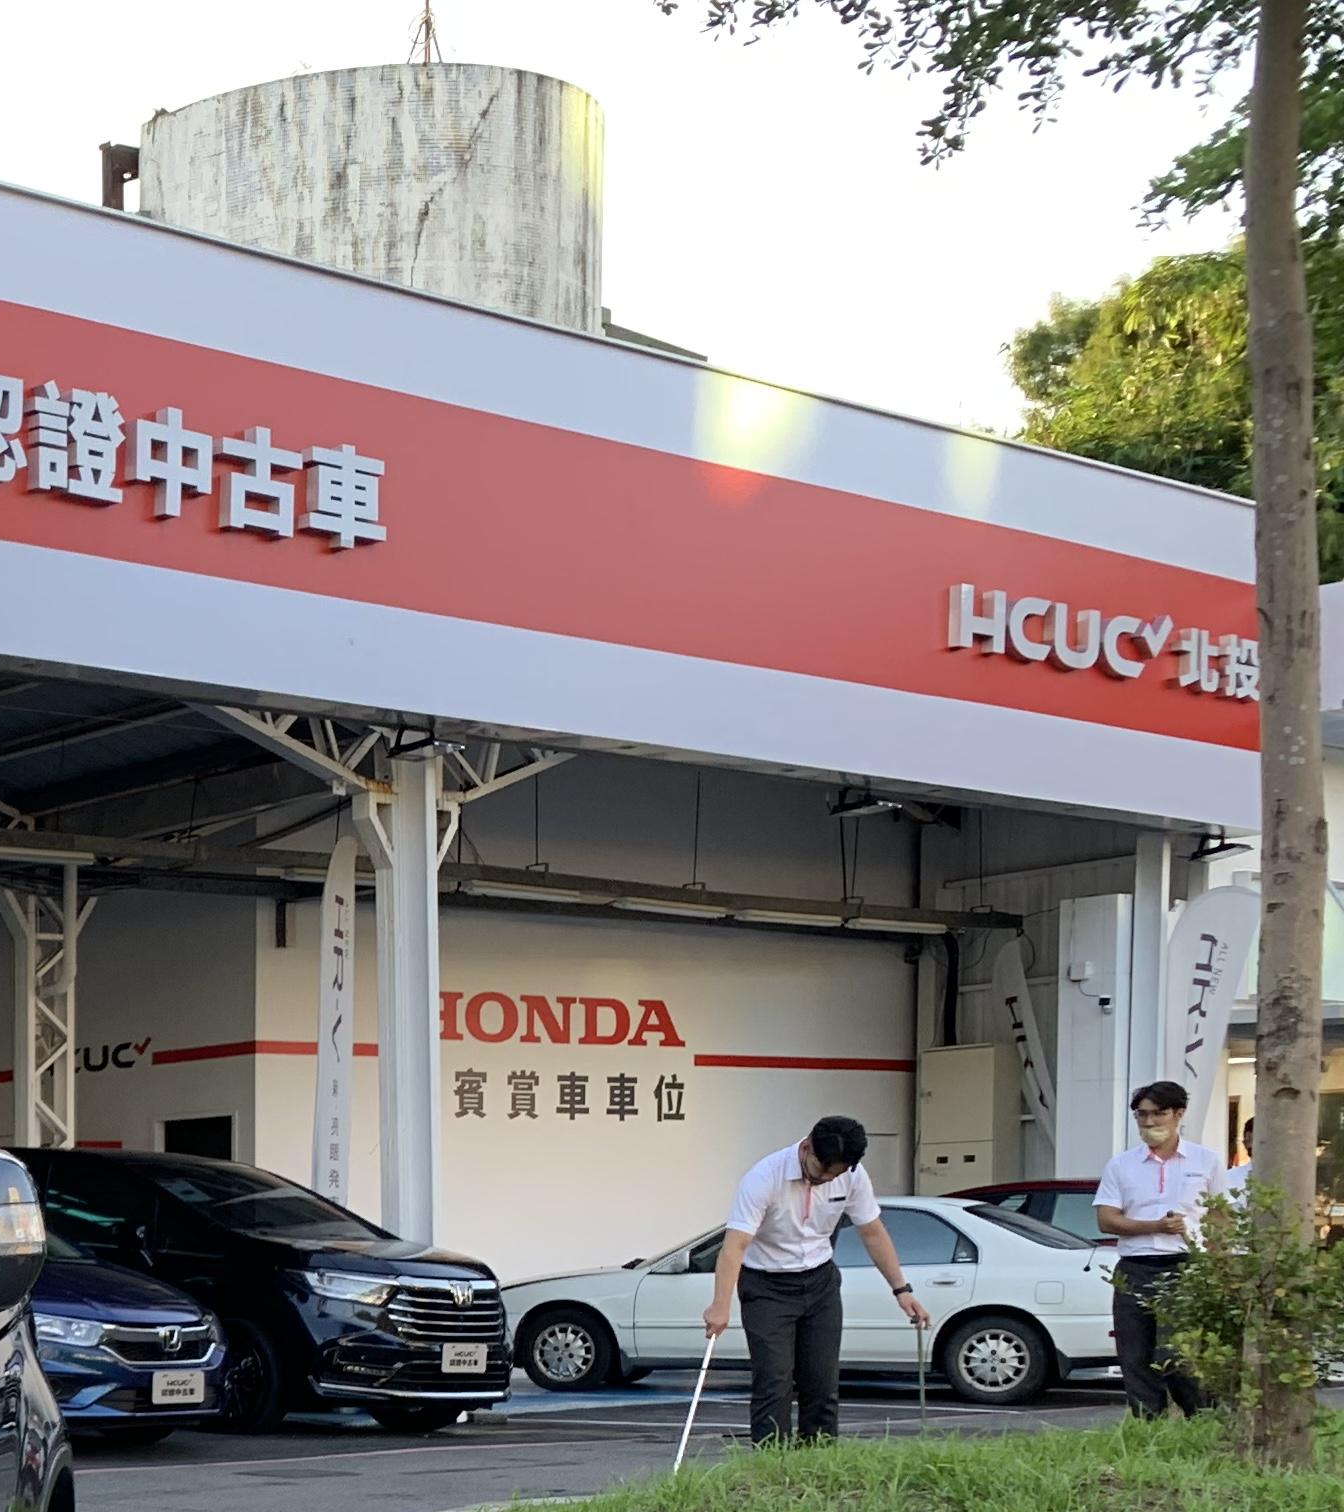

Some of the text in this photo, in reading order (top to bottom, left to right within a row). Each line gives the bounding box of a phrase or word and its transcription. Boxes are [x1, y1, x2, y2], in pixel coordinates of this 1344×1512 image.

[948, 583, 1147, 679] HCUC
[452, 1067, 687, 1122] 賓賞車車位
